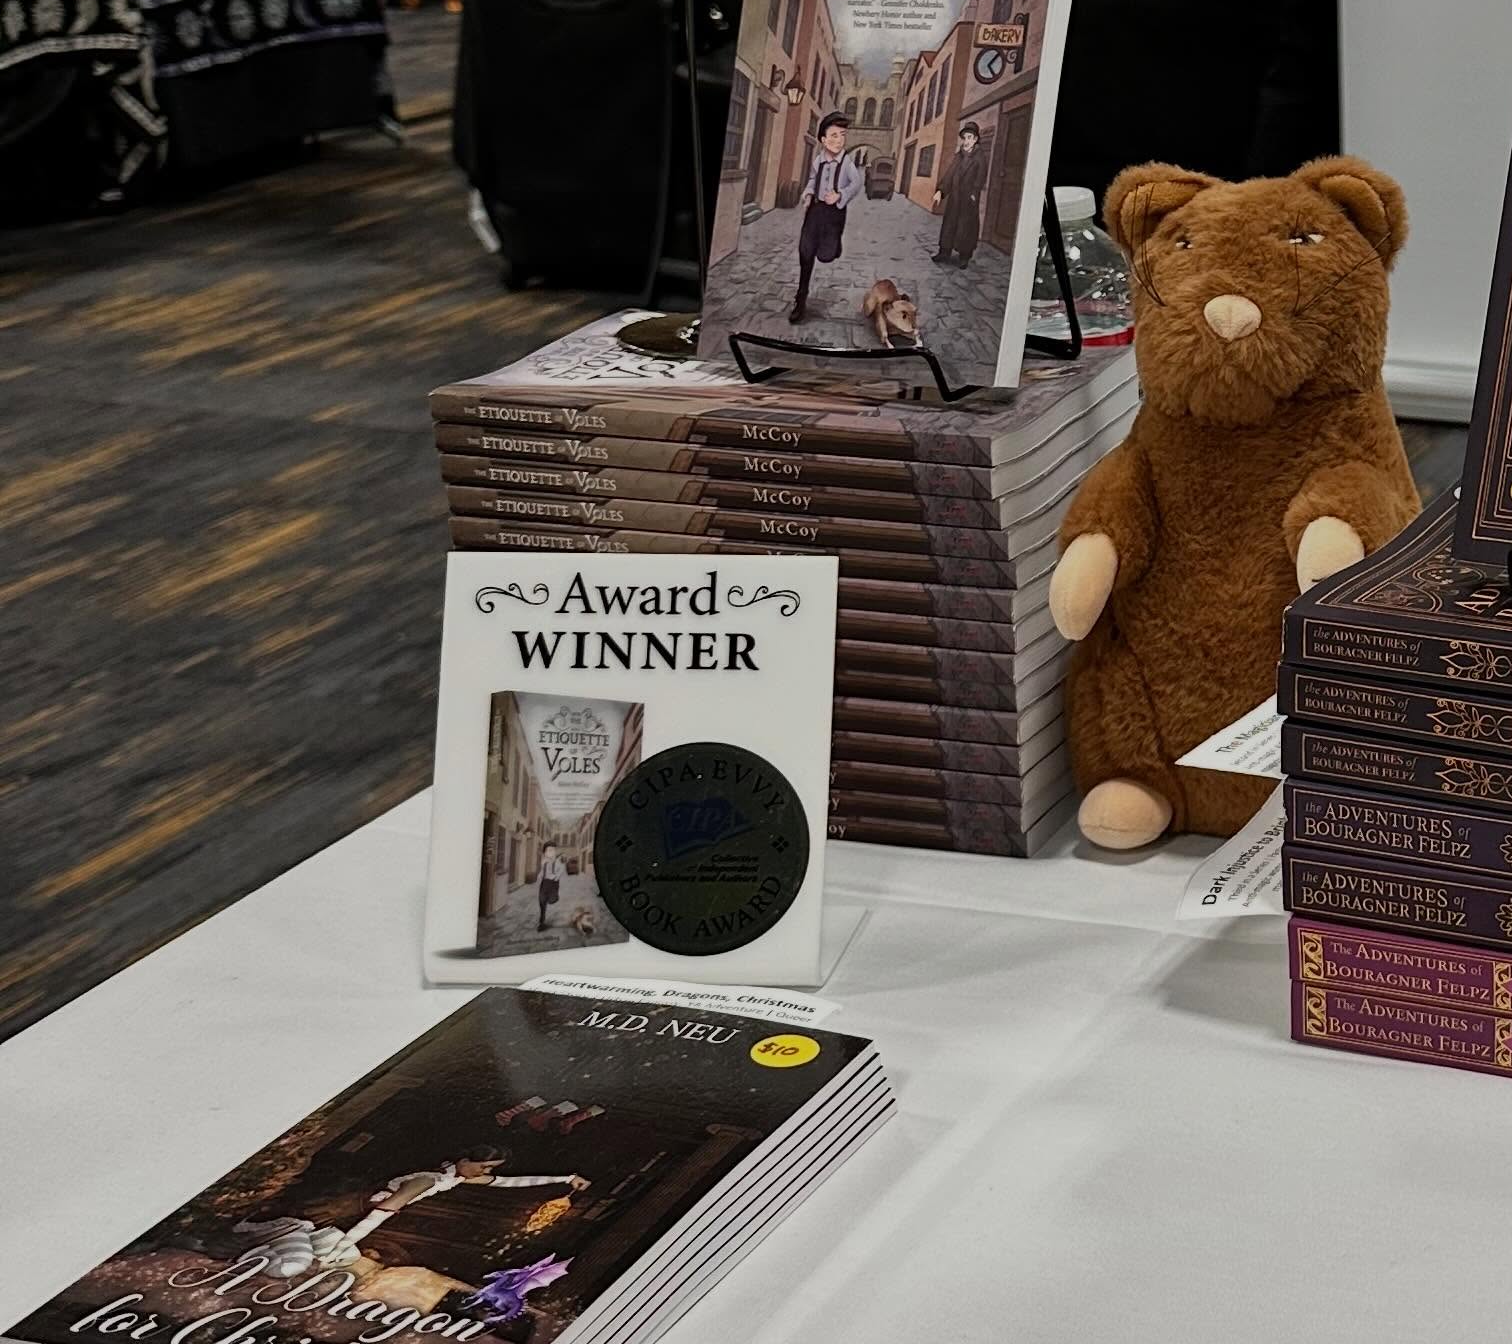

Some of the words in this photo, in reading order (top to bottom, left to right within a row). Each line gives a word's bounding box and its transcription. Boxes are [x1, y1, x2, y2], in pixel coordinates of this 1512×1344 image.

[981, 27, 1023, 44] BAKERY
[478, 406, 552, 425] ETIQUETTE
[562, 408, 608, 431] VOLES
[742, 424, 802, 447] McCoy
[481, 436, 555, 455] ETIQUETTE
[565, 439, 609, 462] VOLES
[744, 456, 802, 479] McCoy
[555, 571, 719, 617] Award
[512, 630, 761, 672] WINNER
[538, 729, 610, 747] ETIQUETTE
[628, 760, 698, 811] CIPA
[712, 759, 786, 812] EVVY
[1304, 817, 1414, 850] BOURAGNER
[1418, 834, 1472, 859] FELPZ
[1324, 802, 1453, 839] ADVENTURES
[1458, 827, 1472, 841] of
[619, 873, 684, 938] BOOK
[693, 875, 782, 939] AWARD
[1202, 870, 1230, 907] Dark
[1330, 941, 1352, 956] The
[1355, 943, 1467, 975] ADVENTURES
[1470, 964, 1483, 976] of
[1325, 960, 1433, 991] BOURAGNER
[1437, 977, 1491, 1001] FELPZ
[663, 988, 731, 1003] Dragons,
[736, 994, 817, 1015] Christmas
[577, 1009, 648, 1034] M.D.
[656, 1019, 742, 1045] NEU
[756, 1041, 801, 1058] $10
[168, 1255, 269, 1298] A
[69, 1293, 172, 1341] for
